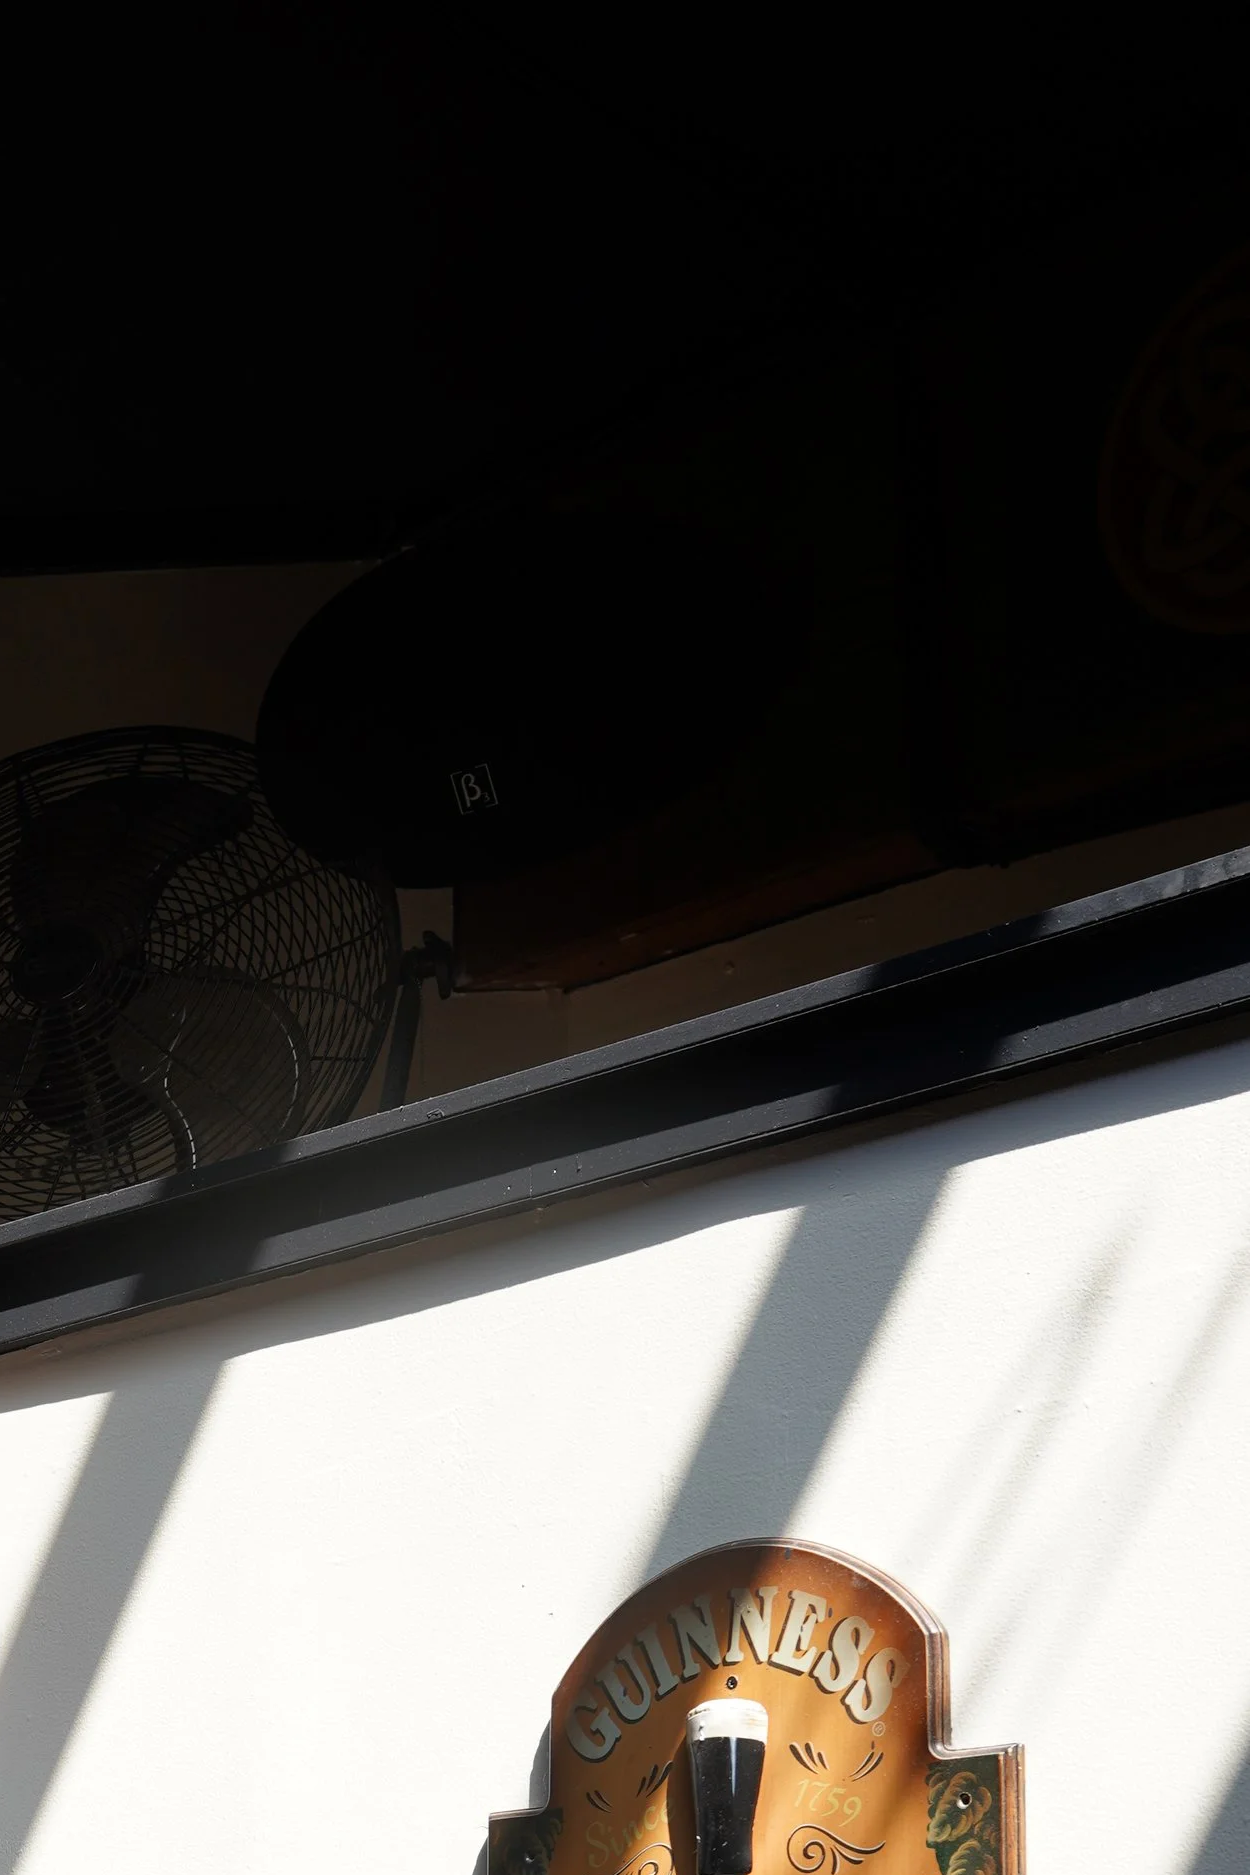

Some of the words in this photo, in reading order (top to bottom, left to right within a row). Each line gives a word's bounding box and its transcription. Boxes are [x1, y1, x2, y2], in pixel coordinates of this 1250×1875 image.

[564, 1586, 910, 1763] GUINNESS
[585, 1801, 679, 1870] Since
[794, 1777, 862, 1827] 1759
